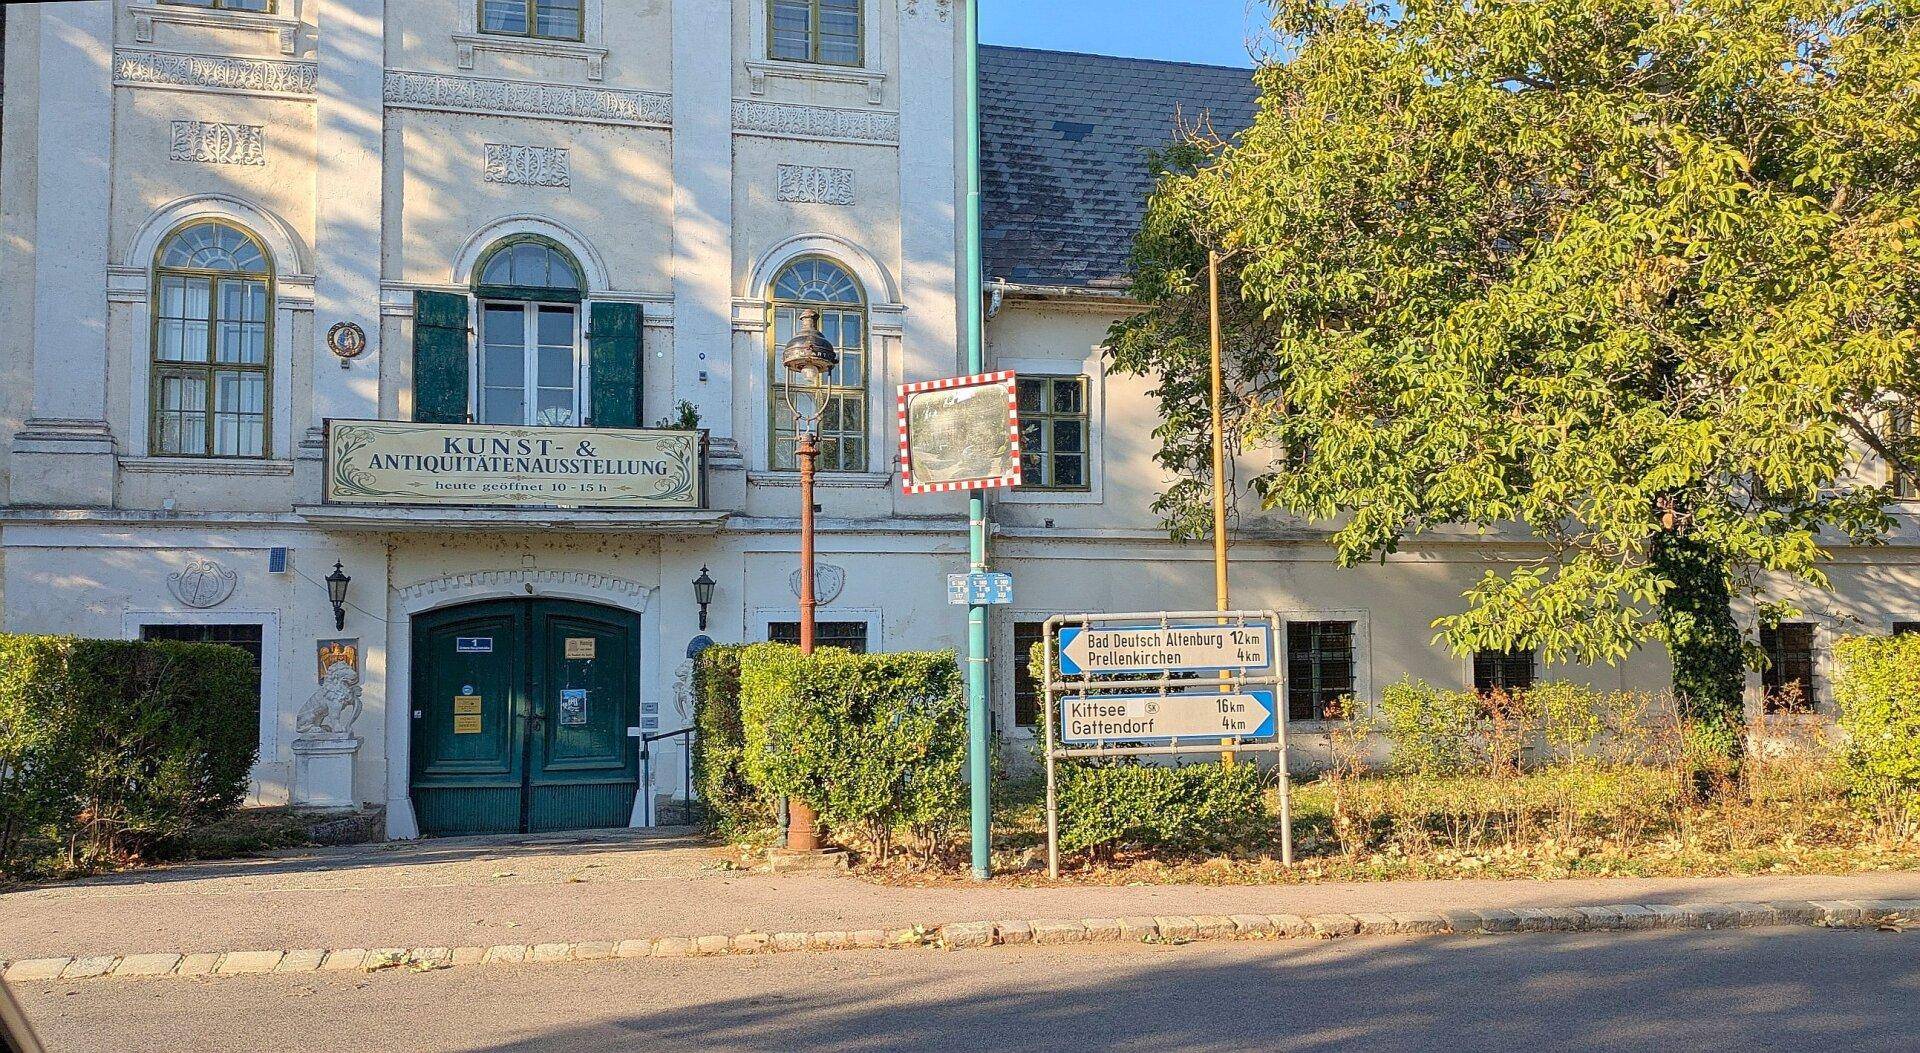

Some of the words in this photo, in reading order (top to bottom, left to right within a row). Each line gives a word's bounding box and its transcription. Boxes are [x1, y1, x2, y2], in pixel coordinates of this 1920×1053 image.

[443, 437, 564, 456] KUNST-
[576, 440, 597, 457] &
[368, 453, 668, 475] ANTIQUITÄTENAUSSTELLUNG
[435, 481, 476, 490] heute
[482, 482, 543, 492] geöffnet
[471, 639, 478, 647] 1
[1088, 634, 1109, 648] Bad
[1114, 633, 1161, 647] Deutsch
[1166, 632, 1223, 649] Altenburg
[1088, 650, 1181, 666] Prellenkirchen
[1072, 702, 1126, 718] Kittsee
[1072, 718, 1155, 735] Gattendorf
